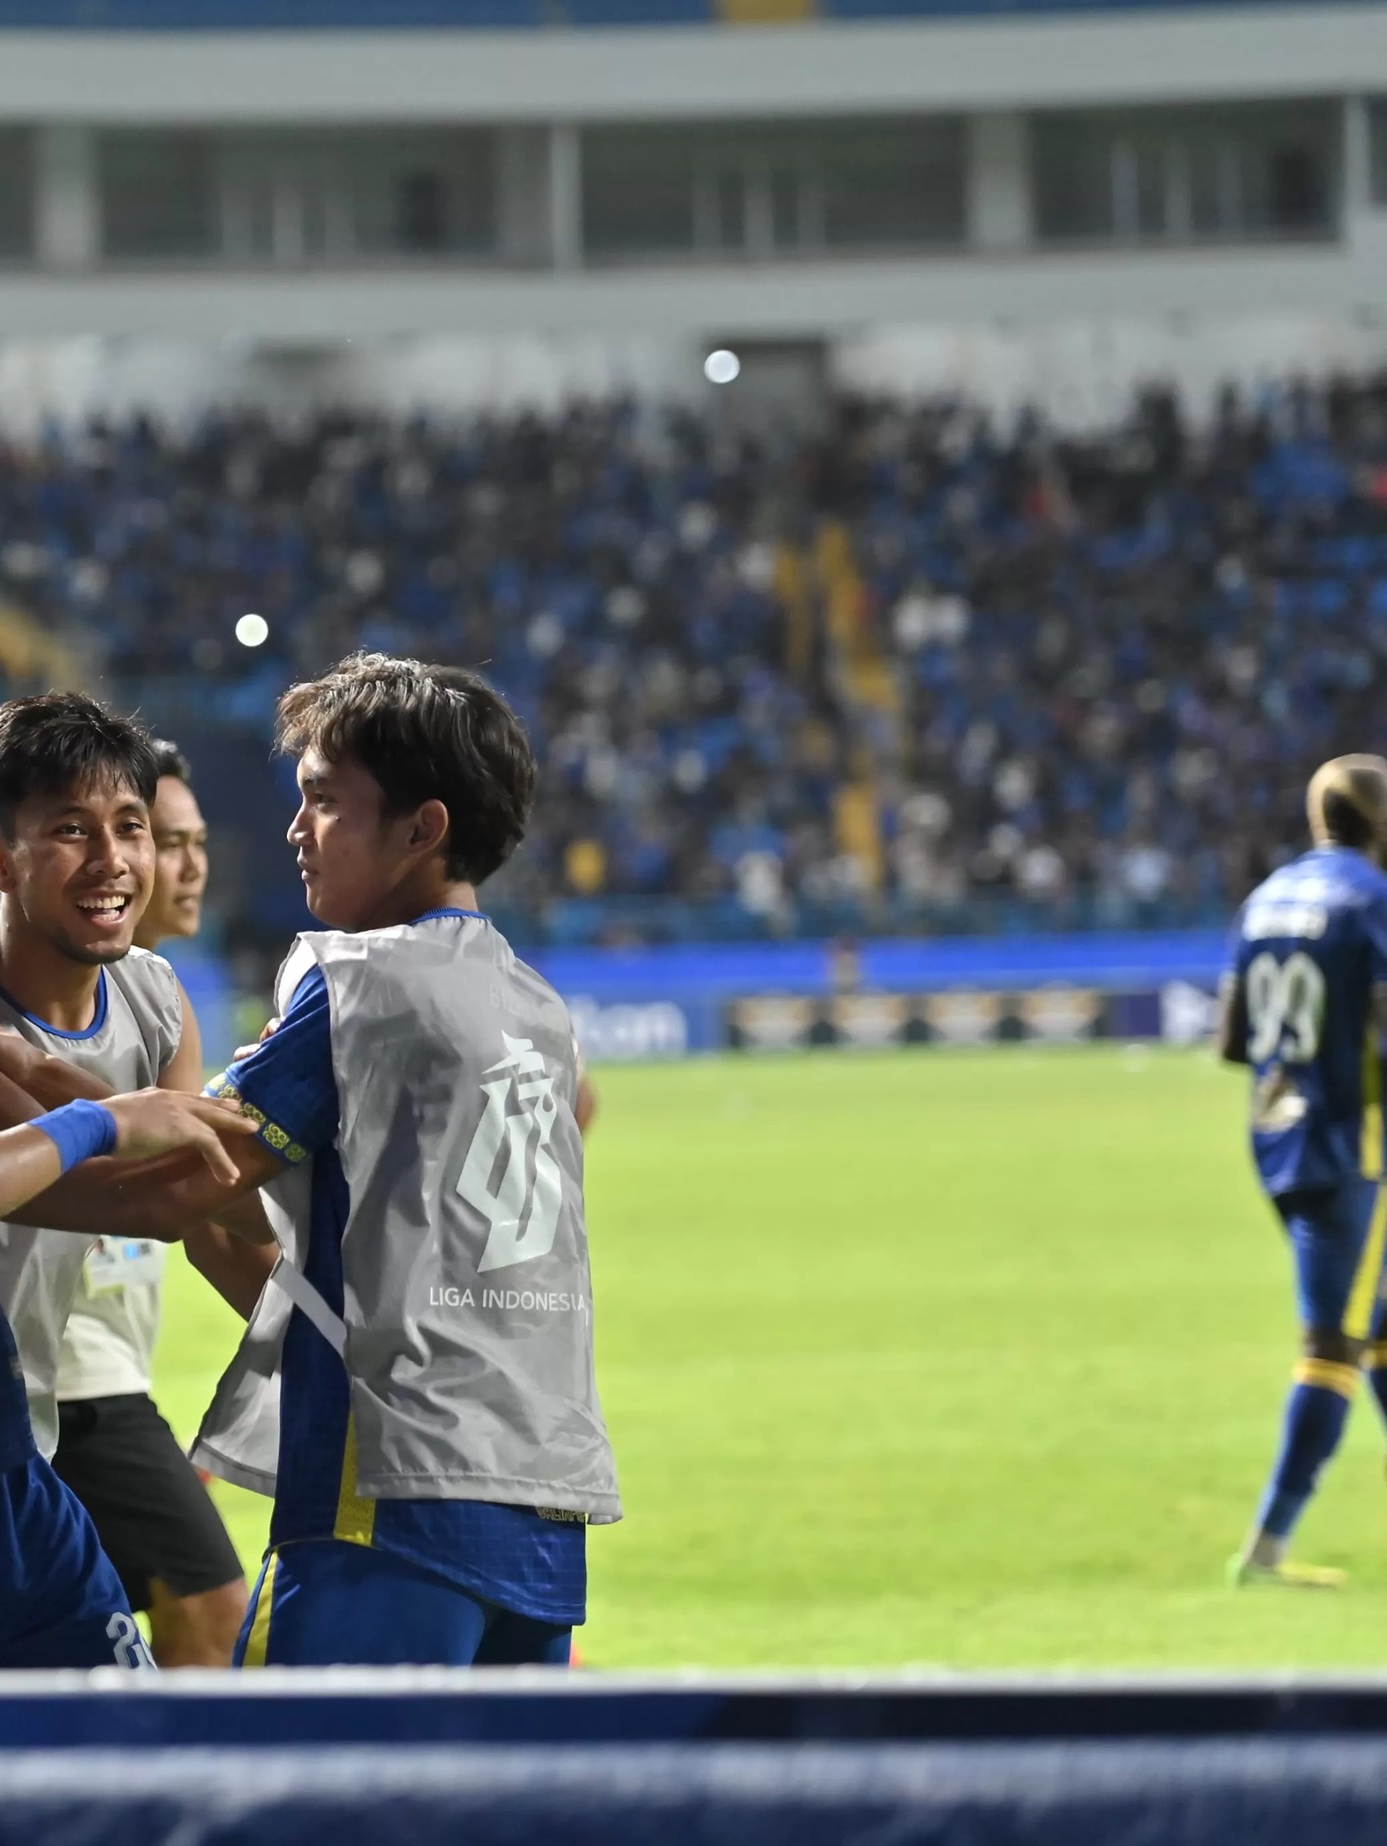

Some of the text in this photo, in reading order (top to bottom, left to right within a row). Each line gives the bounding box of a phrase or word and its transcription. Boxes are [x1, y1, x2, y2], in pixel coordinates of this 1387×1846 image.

[1246, 951, 1325, 1064] 99
[429, 1286, 586, 1312] LIGA INDONESIA
